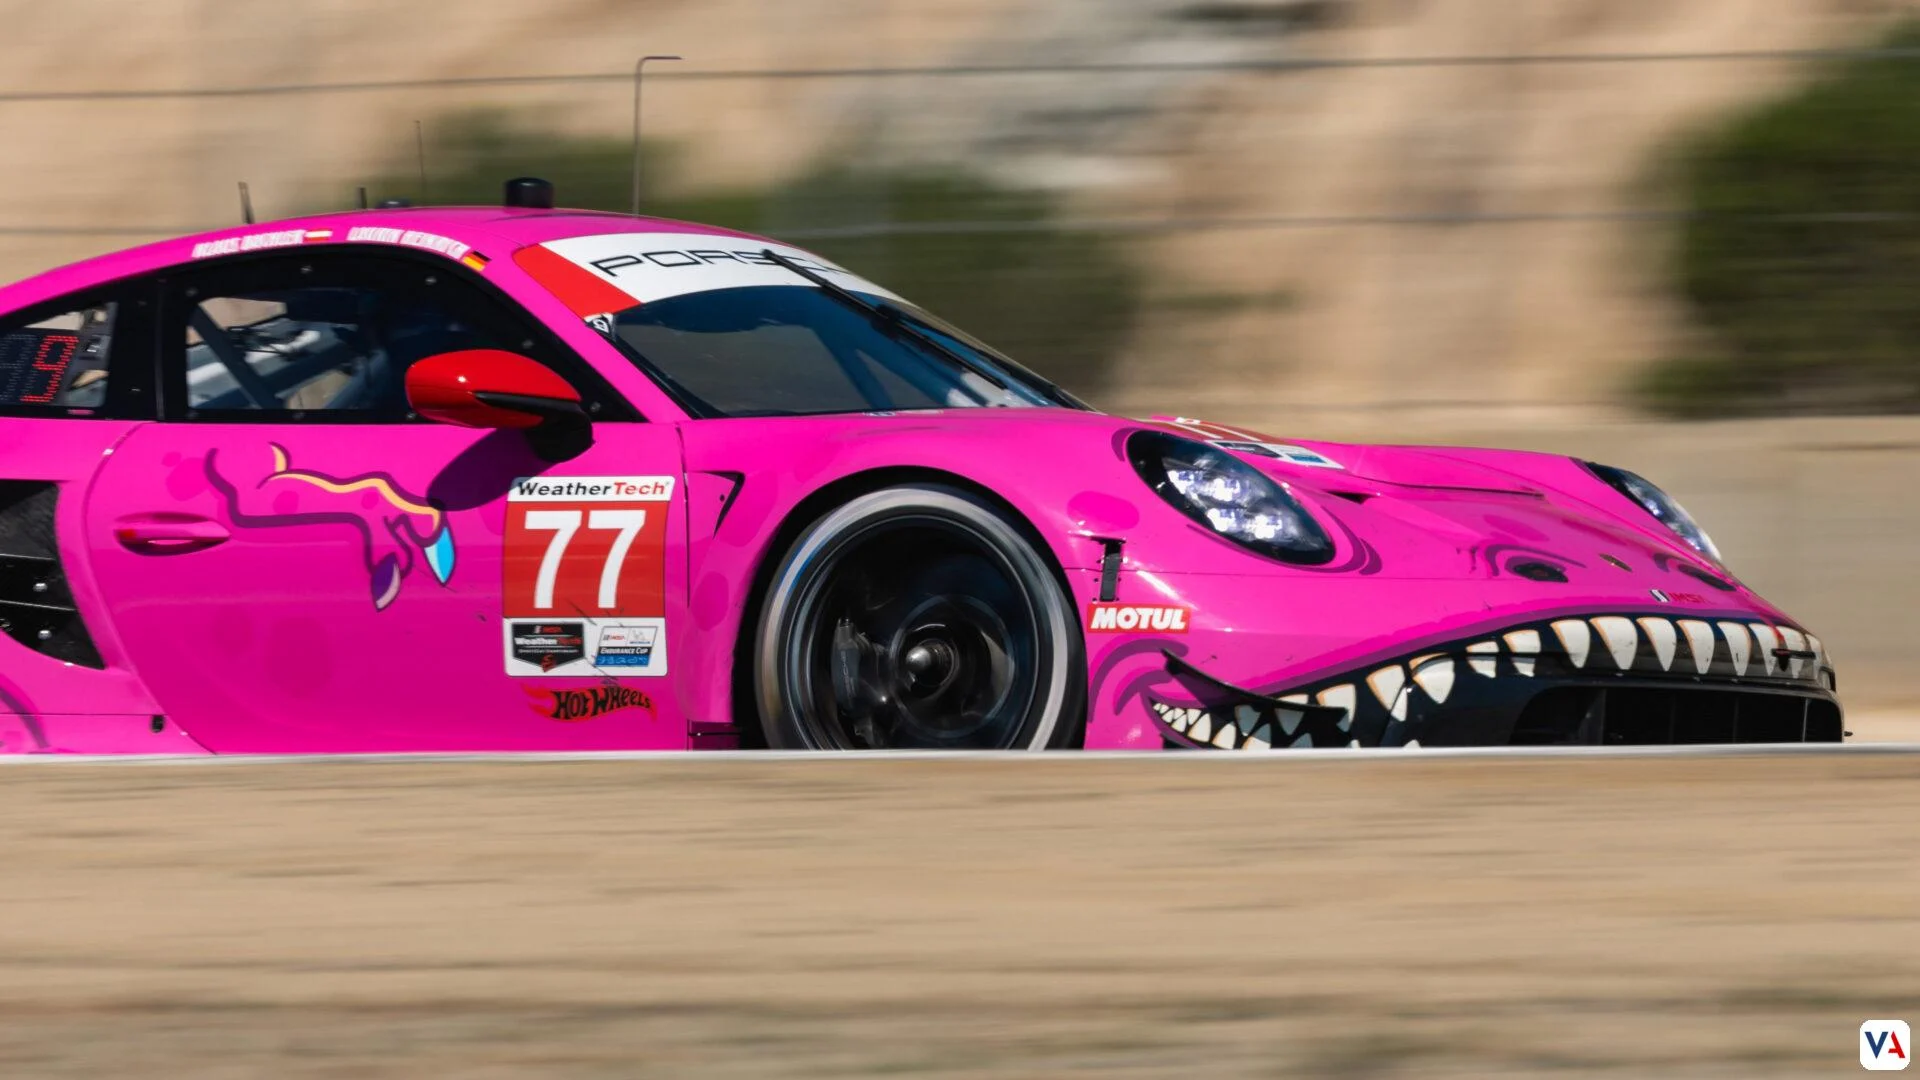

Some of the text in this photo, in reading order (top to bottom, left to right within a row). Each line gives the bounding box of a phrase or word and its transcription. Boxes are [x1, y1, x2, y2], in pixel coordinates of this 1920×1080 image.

[20, 335, 80, 403] 9
[518, 479, 667, 498] WeatherTech
[524, 509, 647, 609] 77
[1090, 607, 1186, 630] MOTUL
